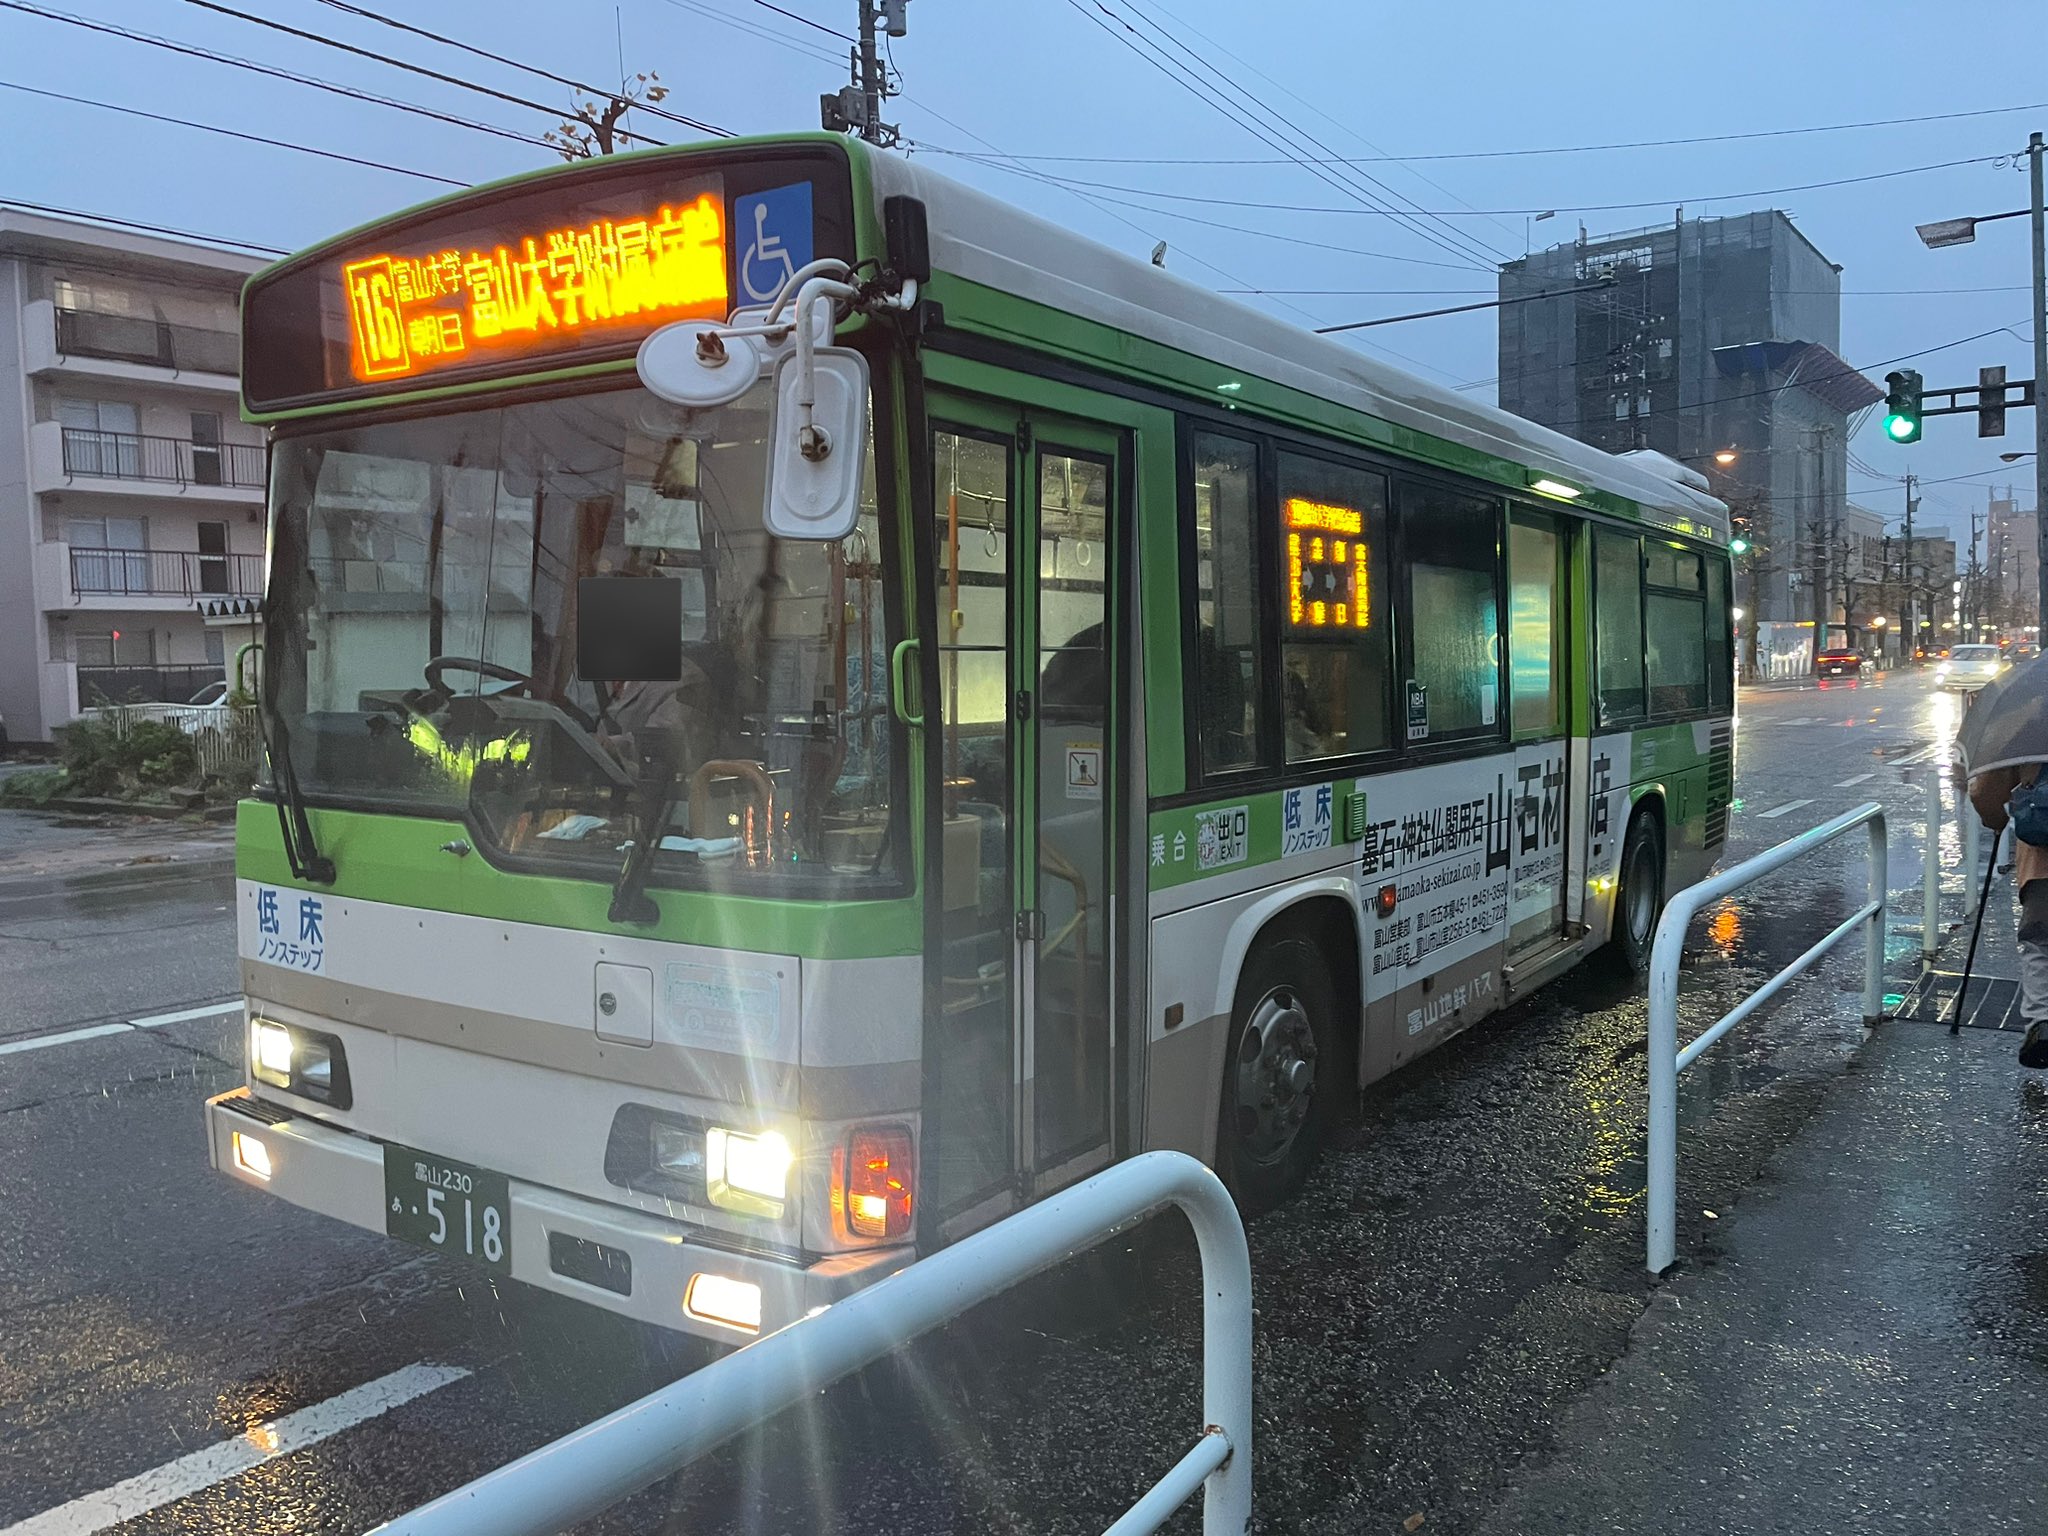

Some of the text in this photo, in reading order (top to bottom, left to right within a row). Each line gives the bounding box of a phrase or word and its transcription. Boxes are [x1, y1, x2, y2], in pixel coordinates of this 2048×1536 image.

[392, 250, 465, 303] 富山大学
[465, 195, 728, 338] 富山大学附属病
[355, 271, 402, 362] 16
[409, 313, 466, 357] 朝日
[1218, 812, 1246, 841] 出口
[1284, 785, 1332, 832] 低床
[1152, 829, 1187, 867] 乗合
[1220, 842, 1242, 860] EXIT
[1283, 825, 1331, 855] ノンステップ
[1362, 861, 1482, 914] wwamaoka-sekizai.co.jp
[257, 887, 323, 945] 低床
[258, 937, 323, 971] ノンステップ
